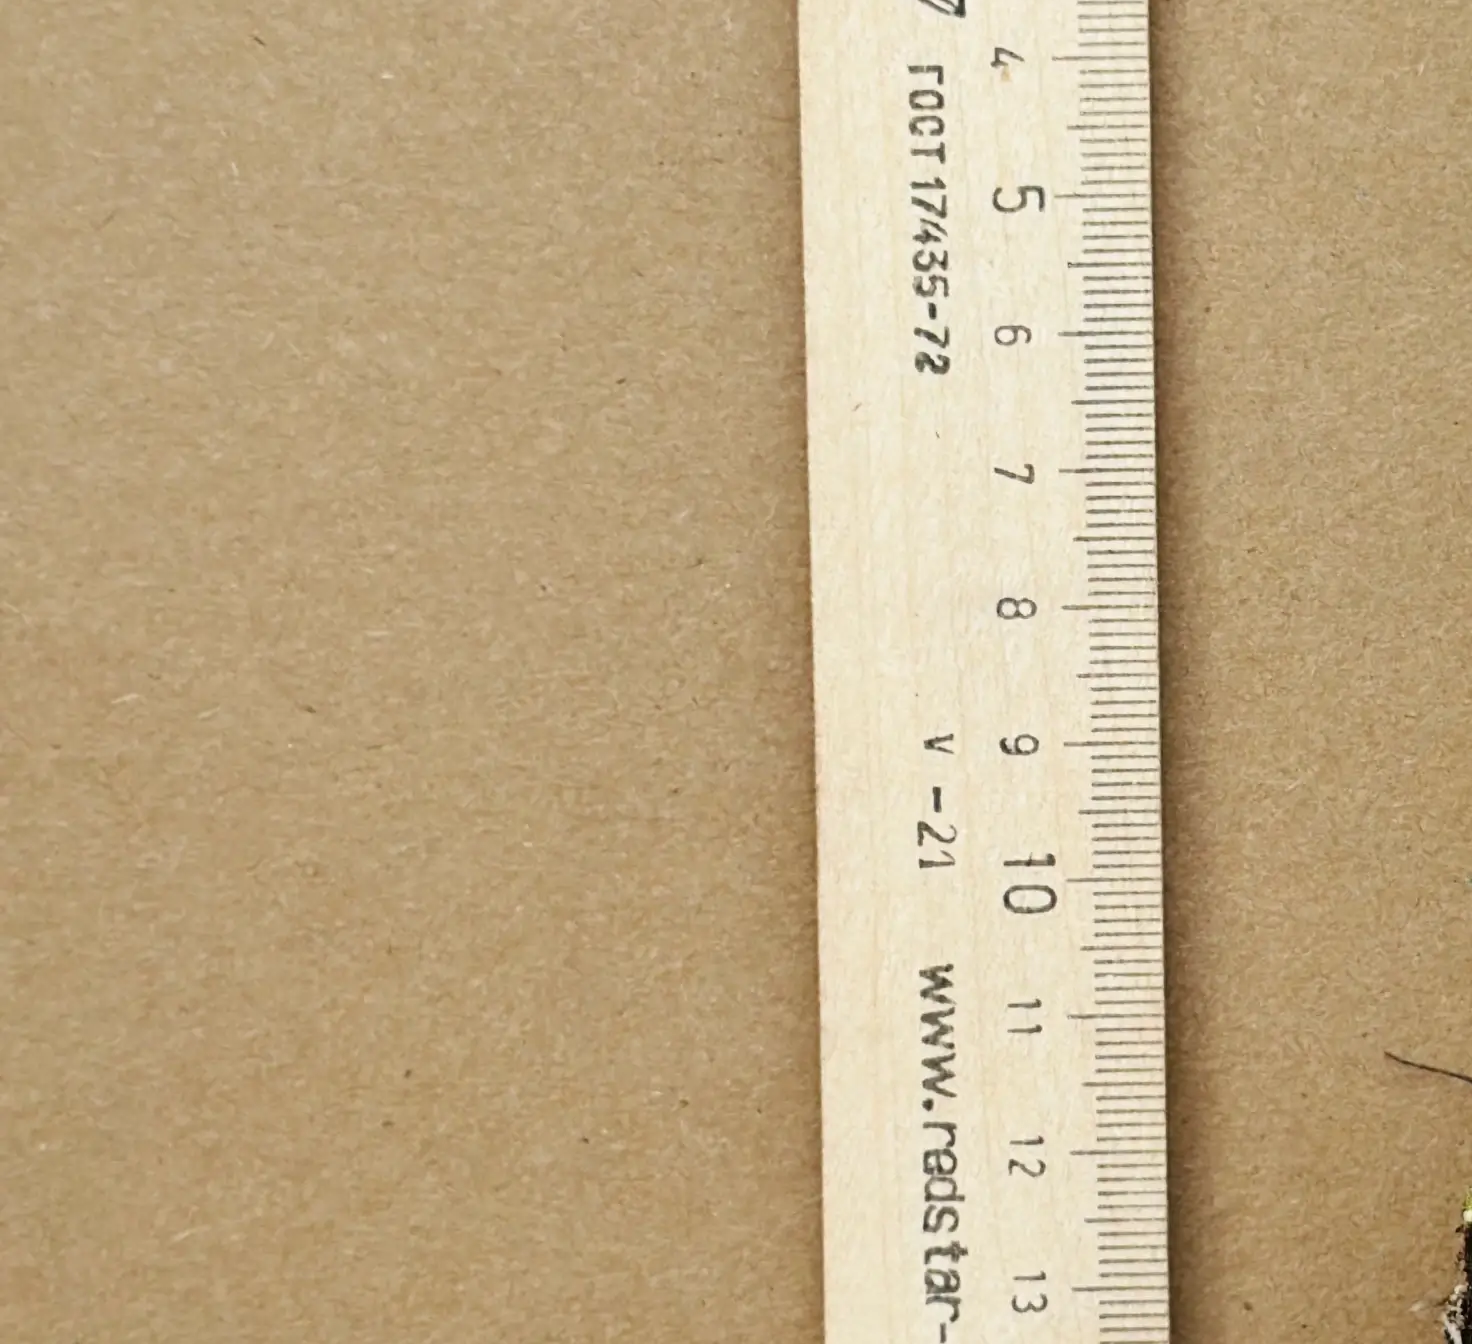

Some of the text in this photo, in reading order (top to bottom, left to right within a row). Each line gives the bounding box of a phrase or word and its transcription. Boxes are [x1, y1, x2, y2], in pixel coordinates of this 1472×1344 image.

[990, 46, 1025, 75] 4
[992, 185, 1046, 214] 5
[907, 64, 951, 376] ГОСТ 17435-72
[993, 324, 1033, 347] 6
[993, 463, 1036, 485] 7
[995, 596, 1038, 621] 8
[998, 733, 1040, 756] 9
[1002, 852, 1058, 915] 10
[1007, 998, 1043, 1036] 11
[1007, 1135, 1047, 1179] 12
[1011, 1270, 1049, 1315] 13
